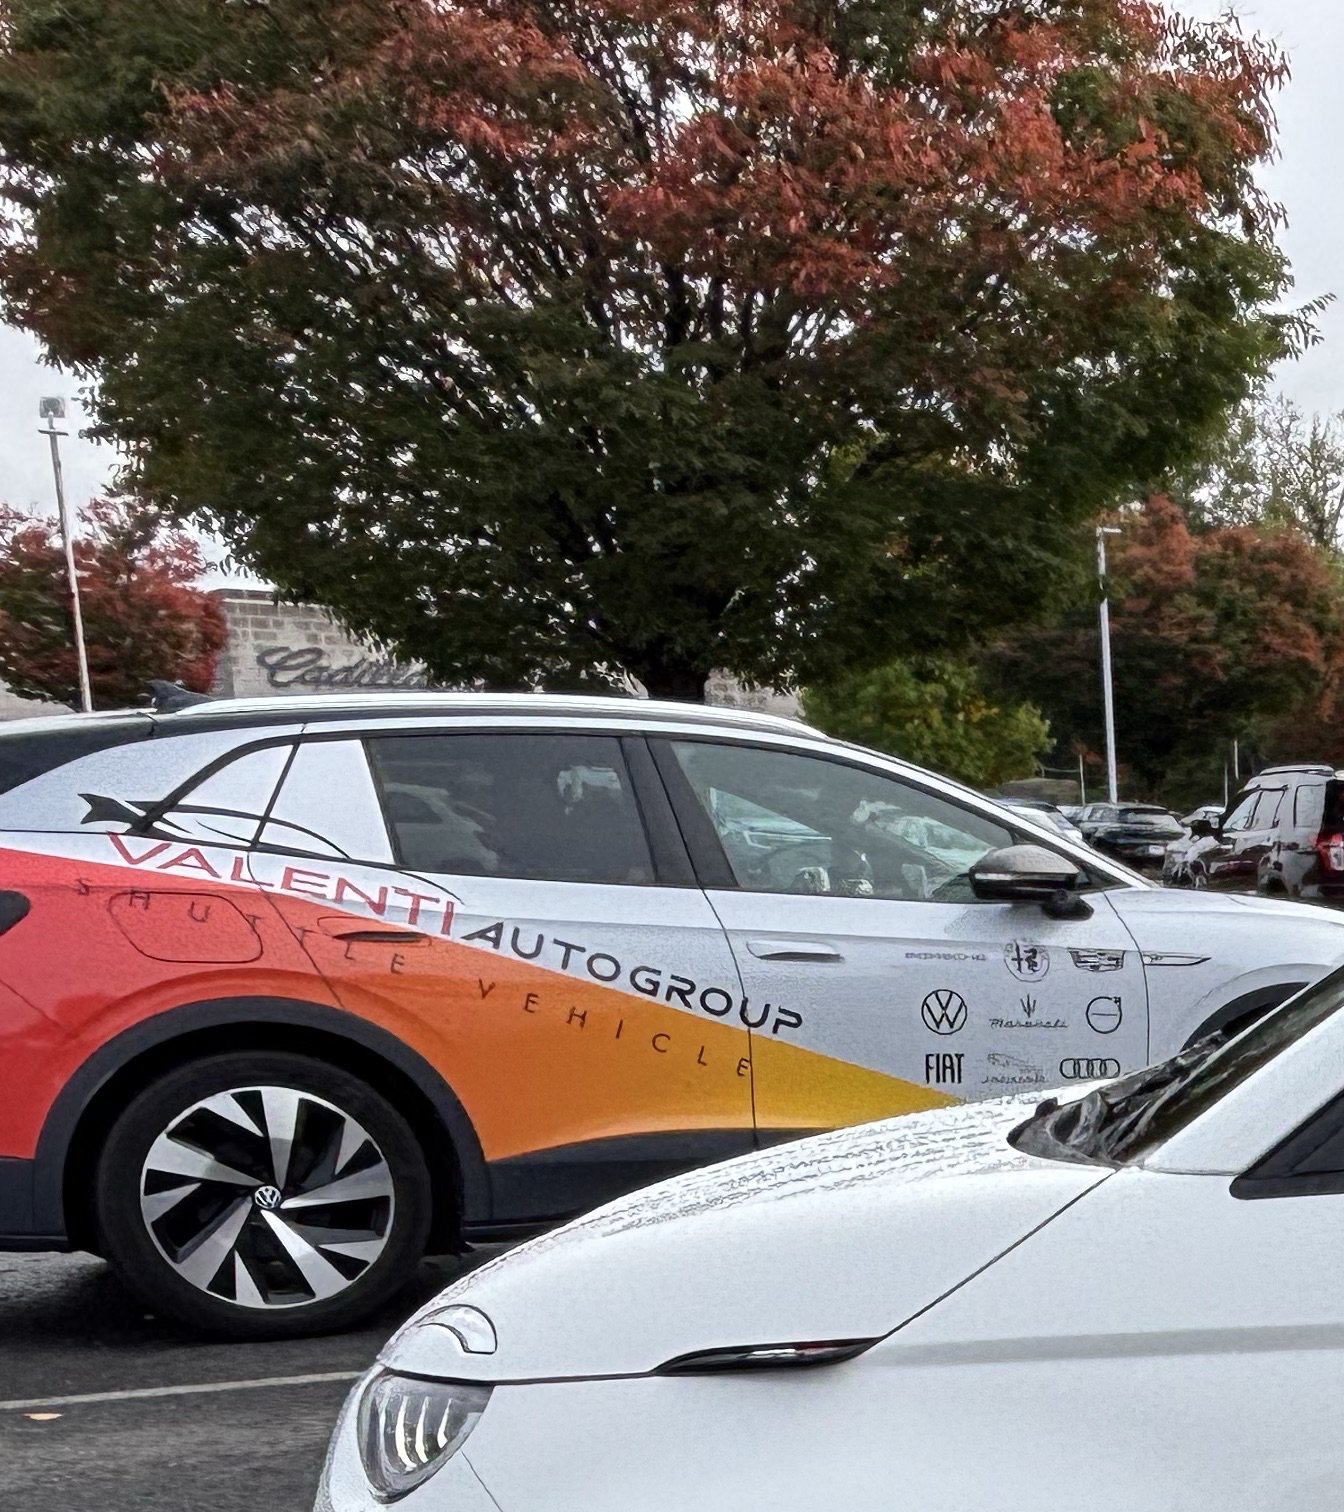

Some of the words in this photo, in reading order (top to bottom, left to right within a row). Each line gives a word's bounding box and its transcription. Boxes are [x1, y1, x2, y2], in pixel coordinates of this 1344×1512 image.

[106, 831, 454, 935] VALENTI
[74, 878, 405, 975] SHUTTLE
[478, 978, 750, 1077] VEHICLE
[925, 1053, 965, 1084] FIAT
